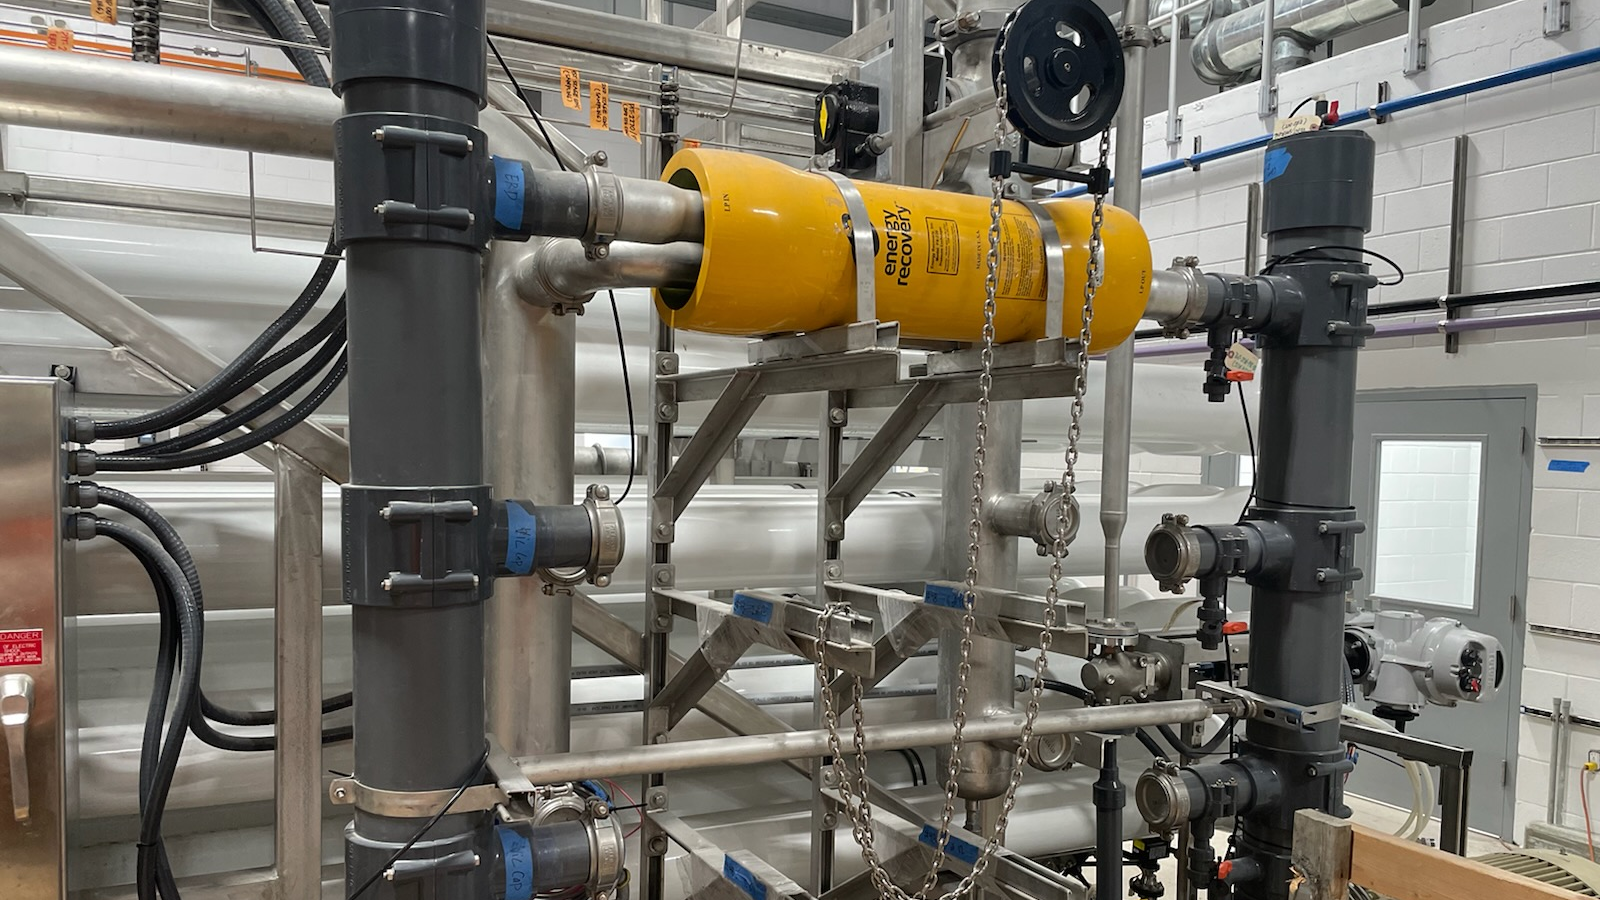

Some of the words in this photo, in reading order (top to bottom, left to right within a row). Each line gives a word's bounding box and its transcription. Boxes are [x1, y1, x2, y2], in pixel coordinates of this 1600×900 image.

[504, 174, 520, 201] ERD
[722, 193, 730, 201] IN
[724, 202, 731, 212] LP
[883, 209, 899, 276] energy
[896, 205, 912, 286] recovery
[0, 632, 39, 640] DANGER
[509, 871, 526, 891] Cap
